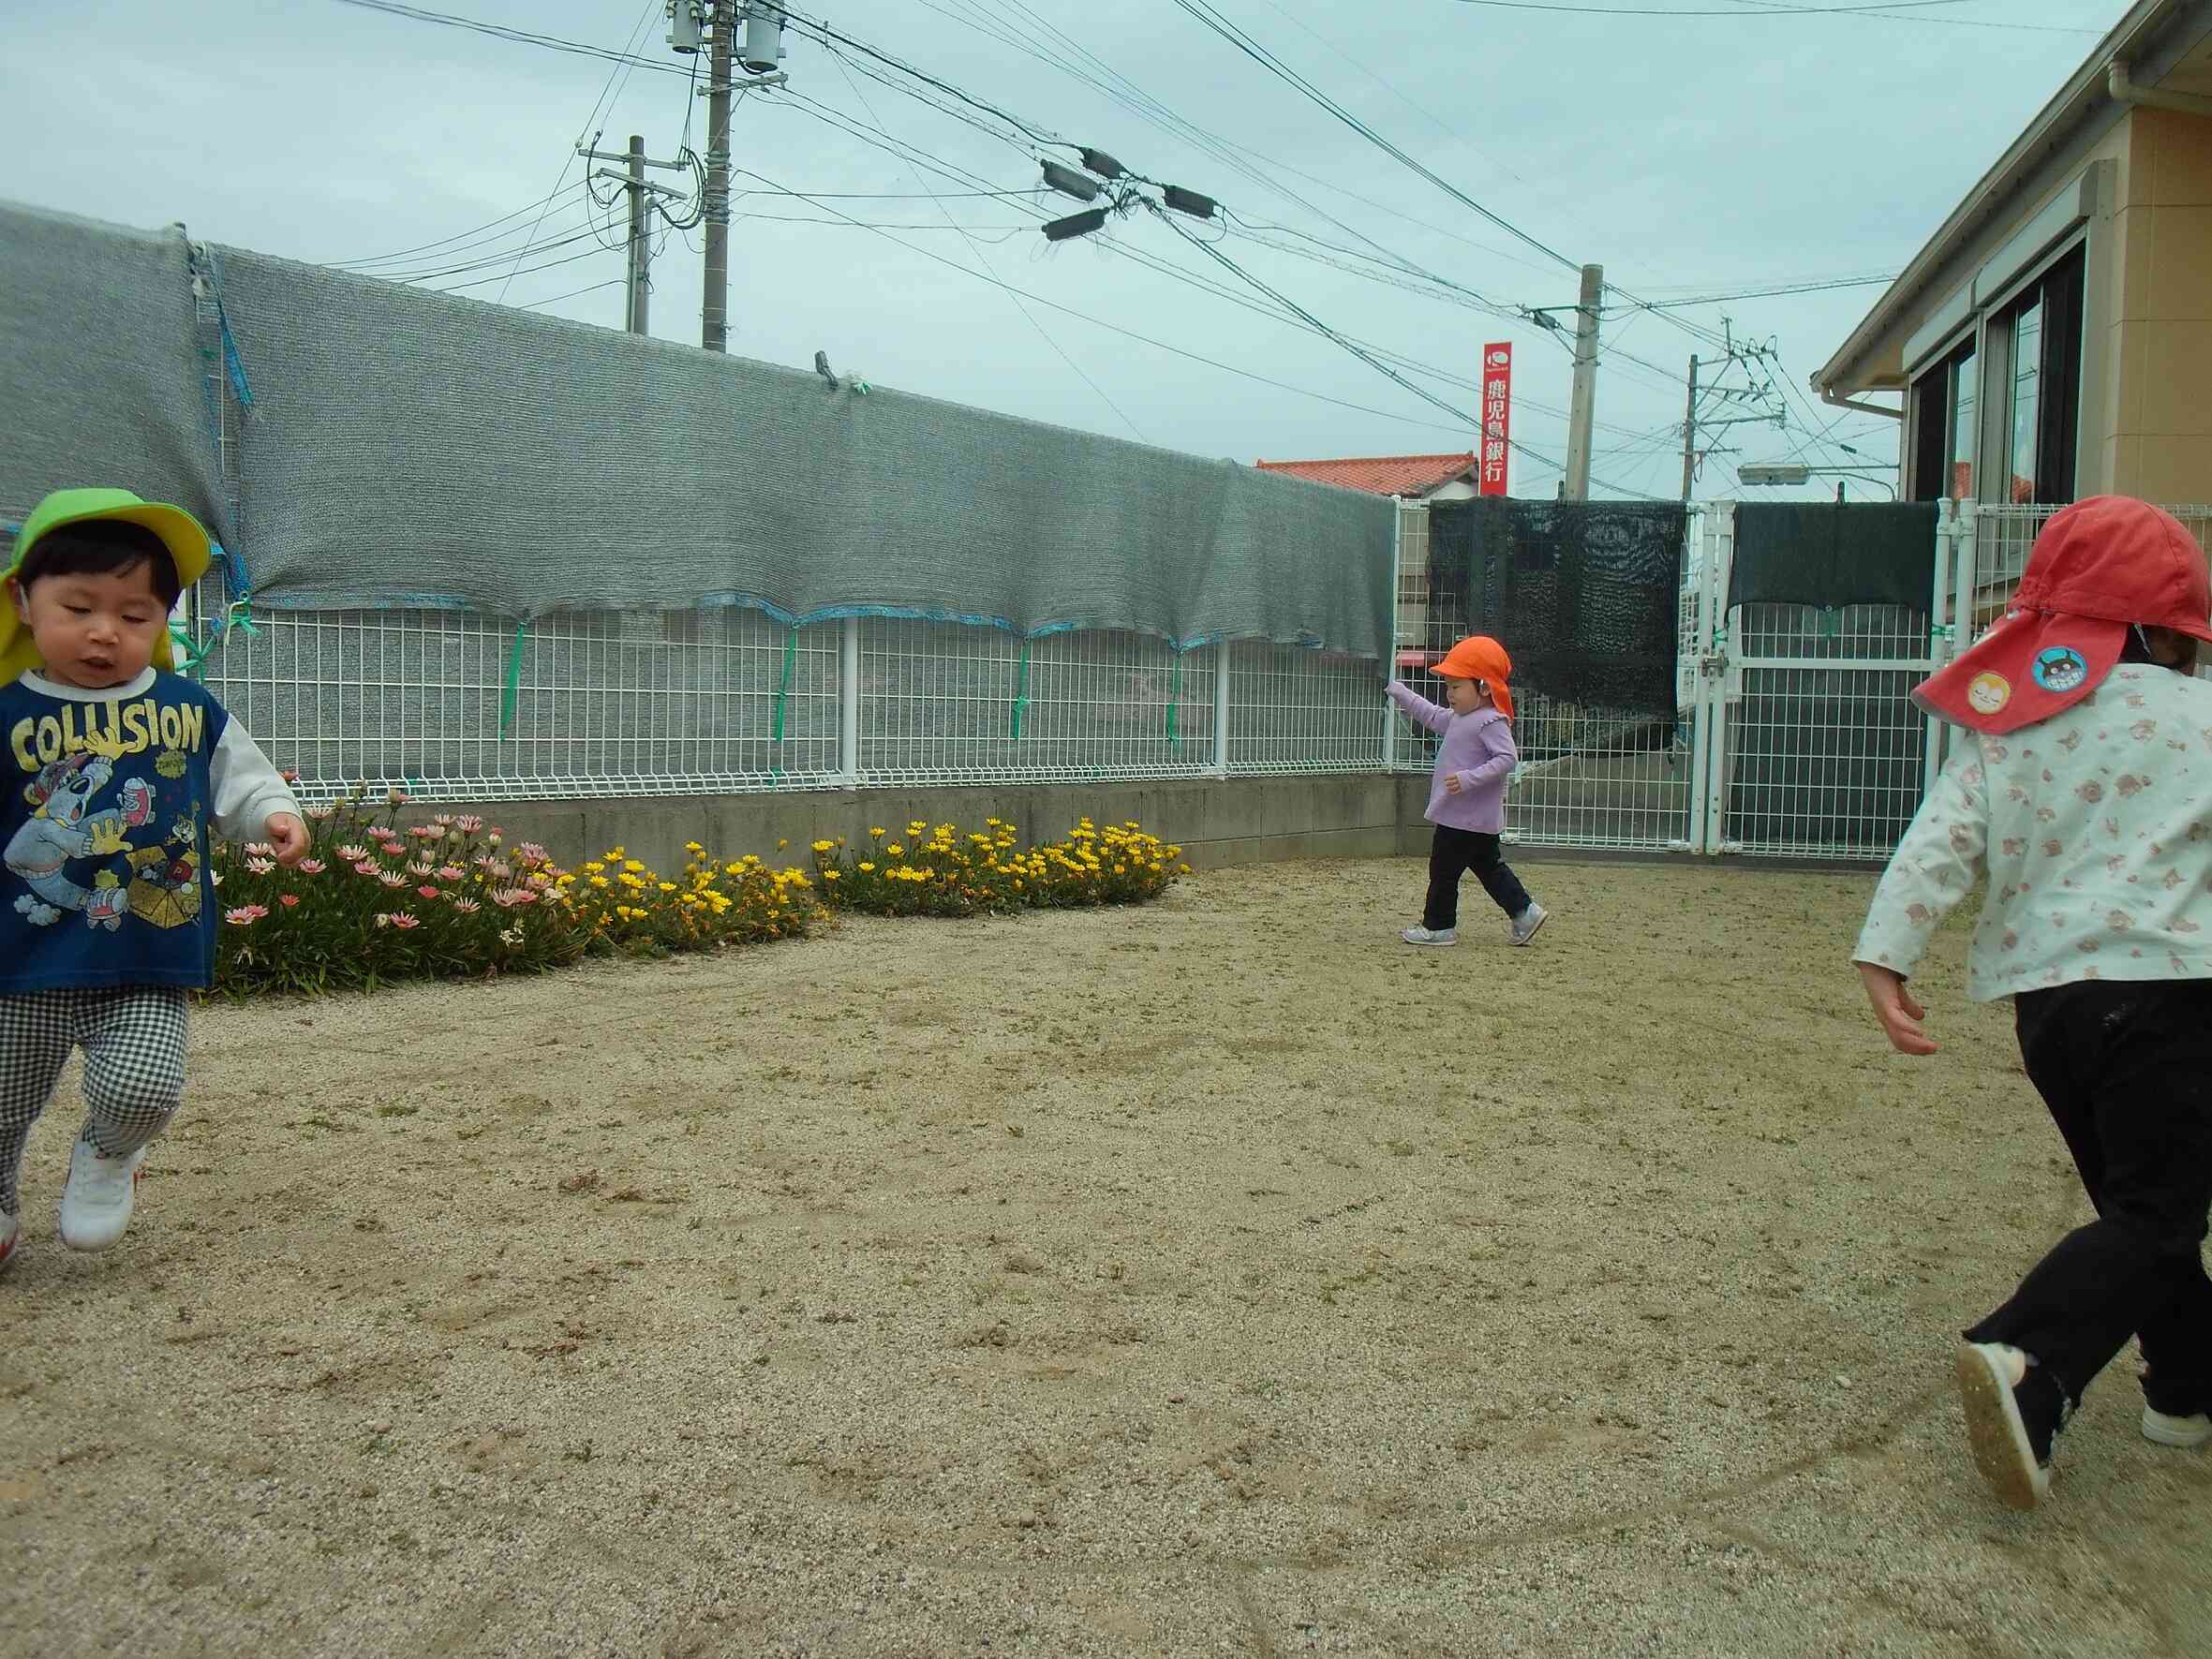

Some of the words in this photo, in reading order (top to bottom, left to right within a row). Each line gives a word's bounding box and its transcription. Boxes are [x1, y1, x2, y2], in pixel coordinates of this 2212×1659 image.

[1485, 378, 1507, 482] 鹿児島銀行
